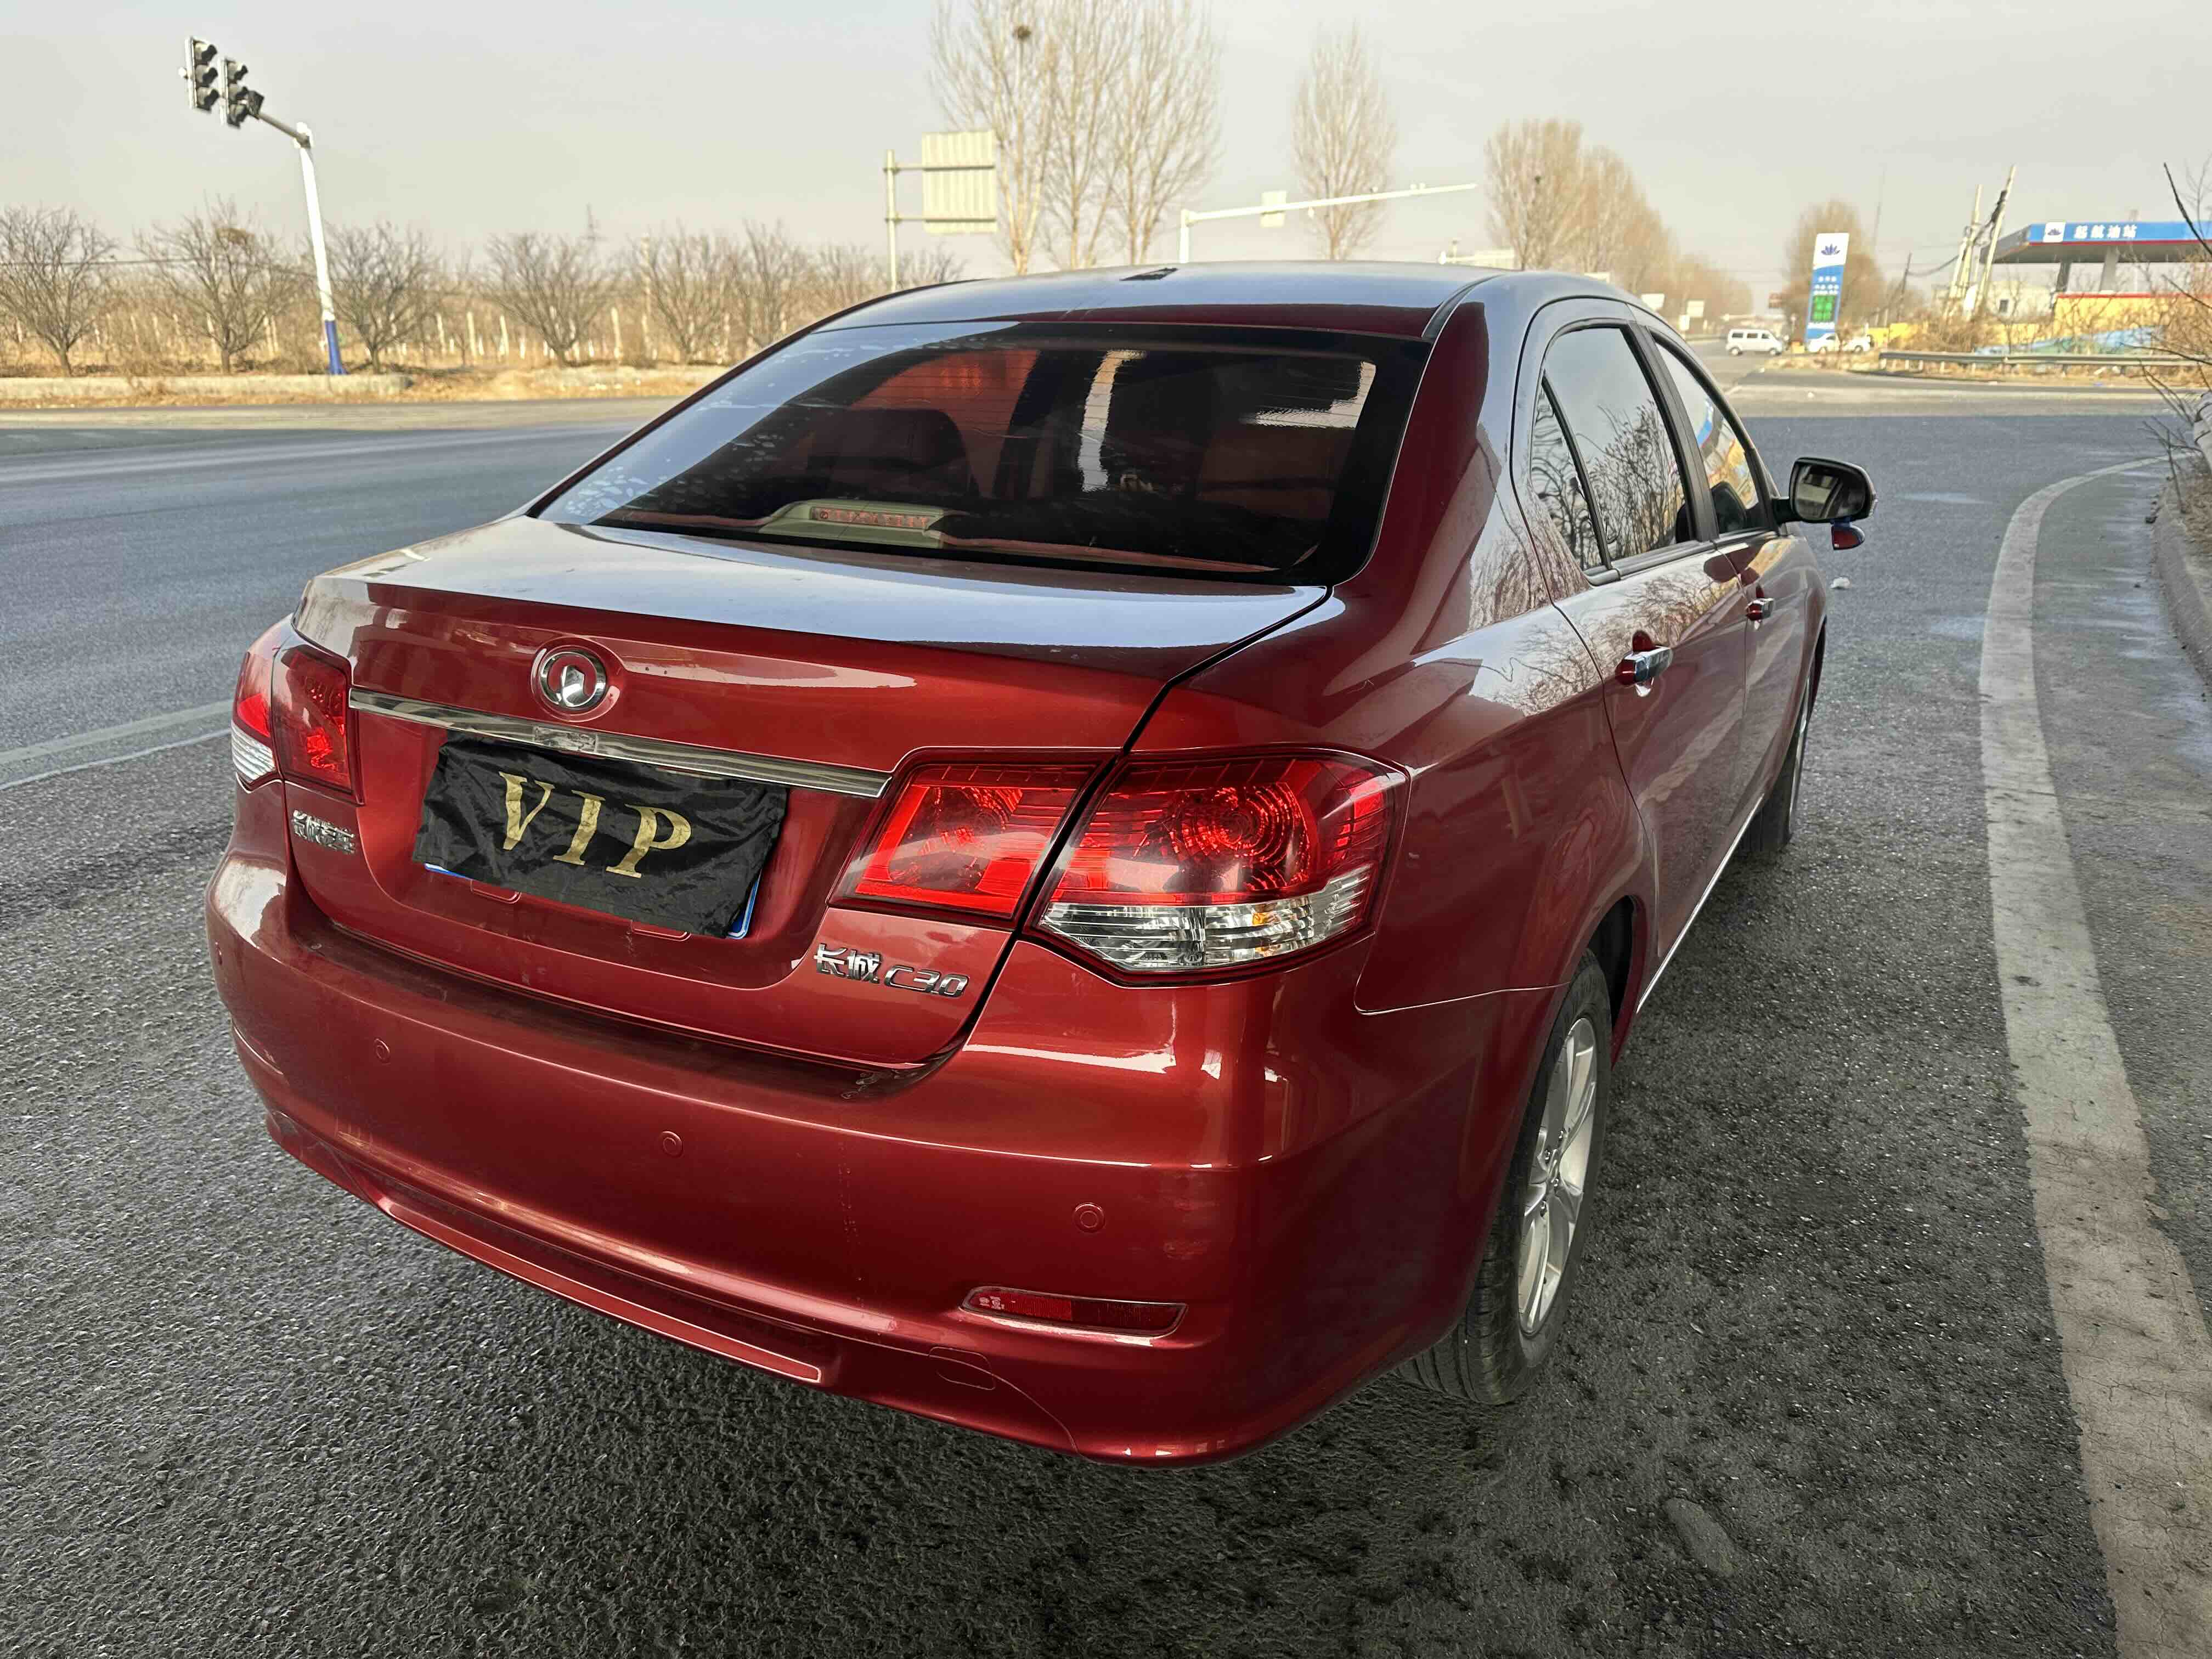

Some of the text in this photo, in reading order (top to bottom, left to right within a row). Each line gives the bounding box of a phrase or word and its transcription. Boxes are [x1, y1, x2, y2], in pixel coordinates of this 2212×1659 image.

[498, 771, 692, 878] VIP
[814, 943, 970, 997] 长城 C30
